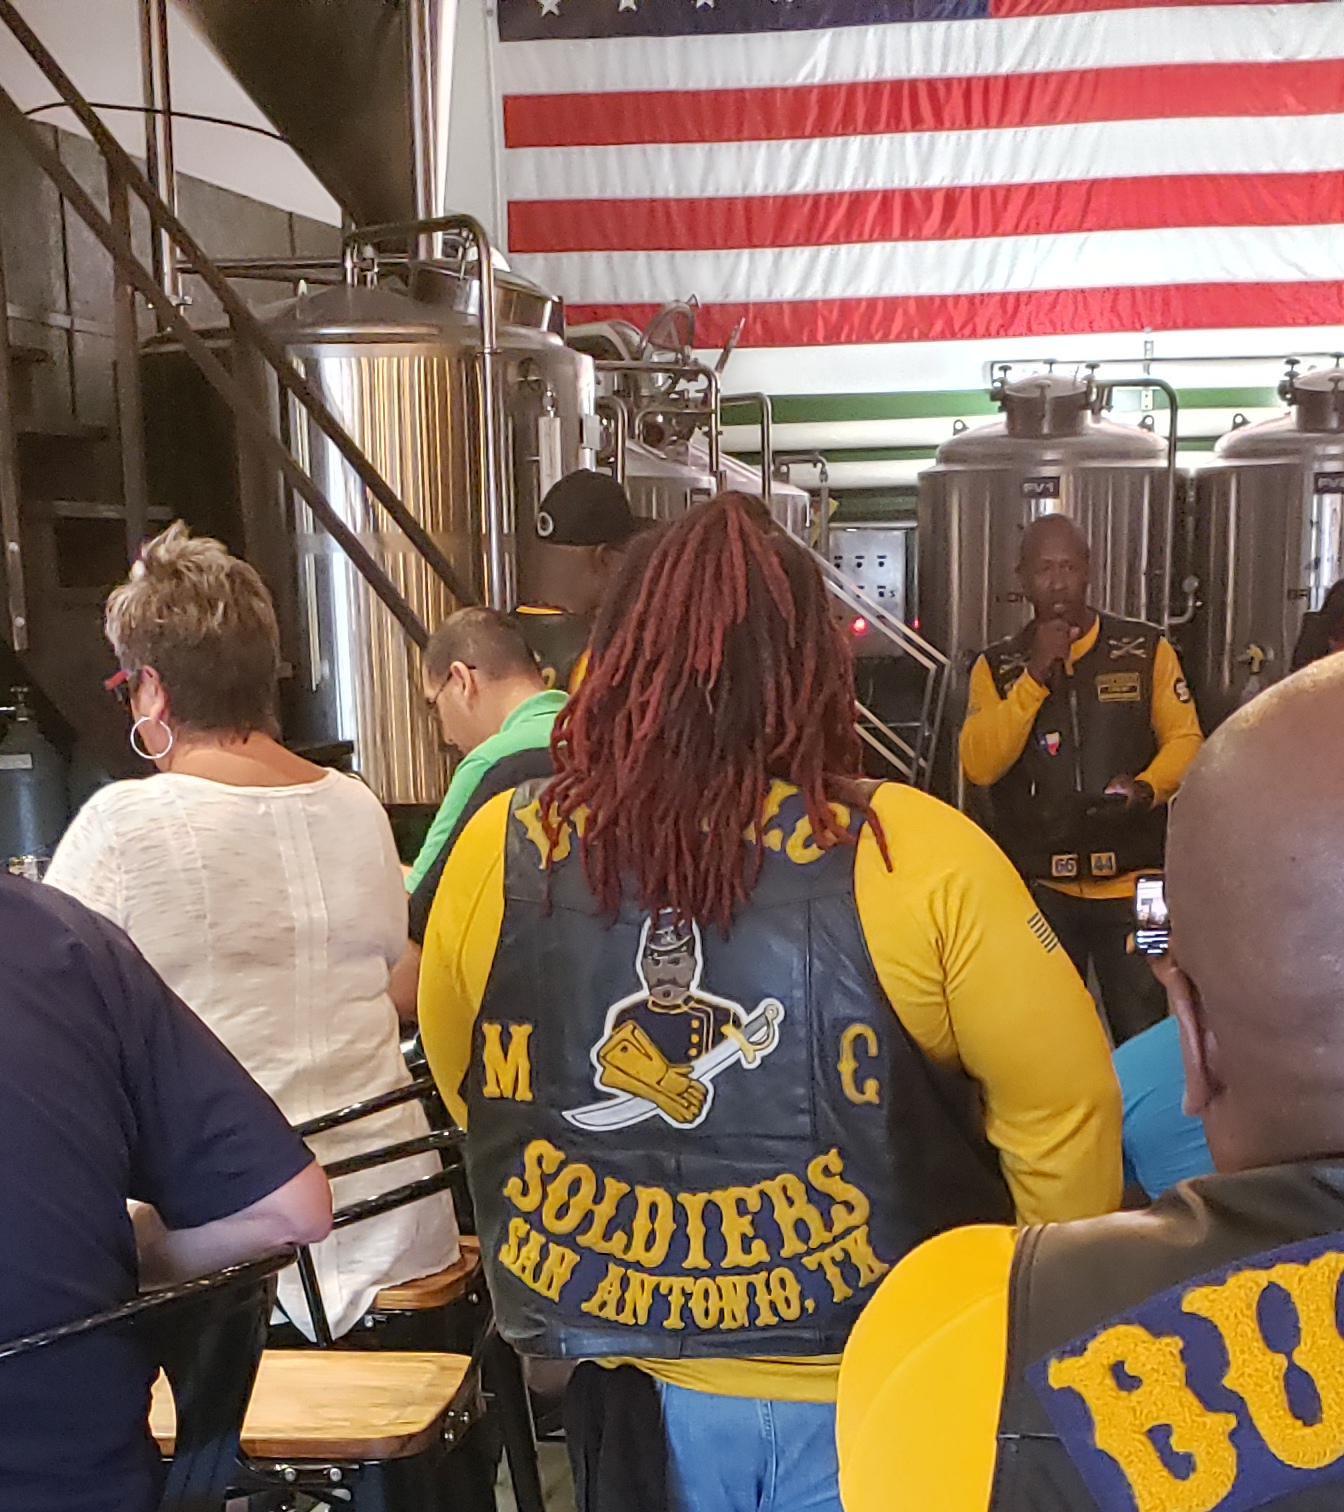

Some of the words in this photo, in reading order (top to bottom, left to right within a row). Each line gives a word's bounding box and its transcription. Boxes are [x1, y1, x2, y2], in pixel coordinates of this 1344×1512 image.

[1023, 482, 1054, 493] FV1
[482, 1022, 533, 1101] M
[837, 1023, 880, 1104] C
[503, 1139, 870, 1269] SOLDIERS
[498, 1217, 580, 1302] SAN
[581, 1262, 815, 1330] ANTONIO,
[801, 1225, 890, 1302] TX
